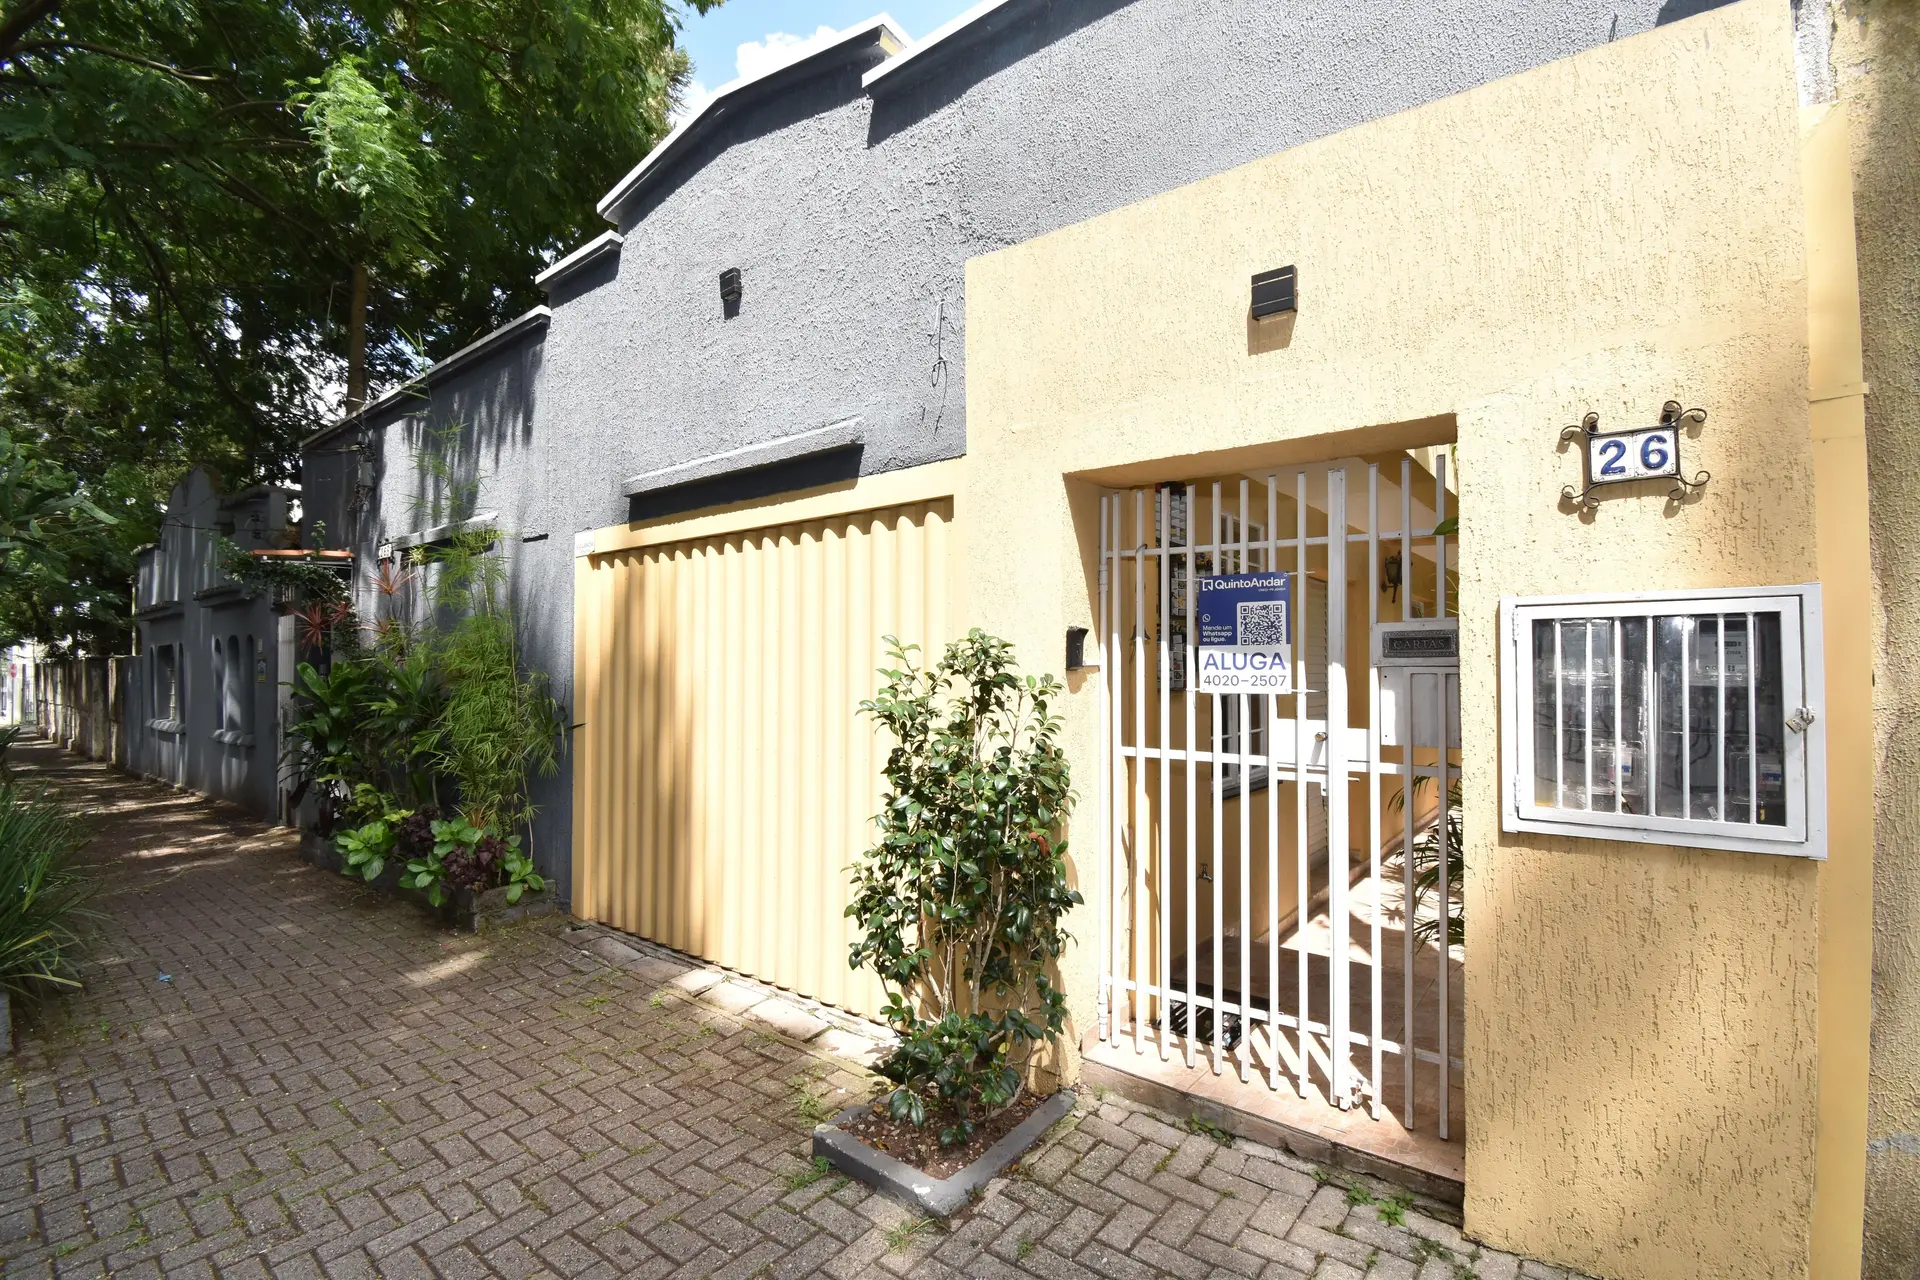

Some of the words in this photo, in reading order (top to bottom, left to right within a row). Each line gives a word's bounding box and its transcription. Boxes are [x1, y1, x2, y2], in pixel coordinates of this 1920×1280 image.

[1599, 434, 1669, 475] 26
[1214, 577, 1286, 590] QuintoAndar
[1393, 639, 1445, 650] CARTAS
[1203, 652, 1287, 670] ALUGA
[1203, 675, 1287, 687] 4020-2507
